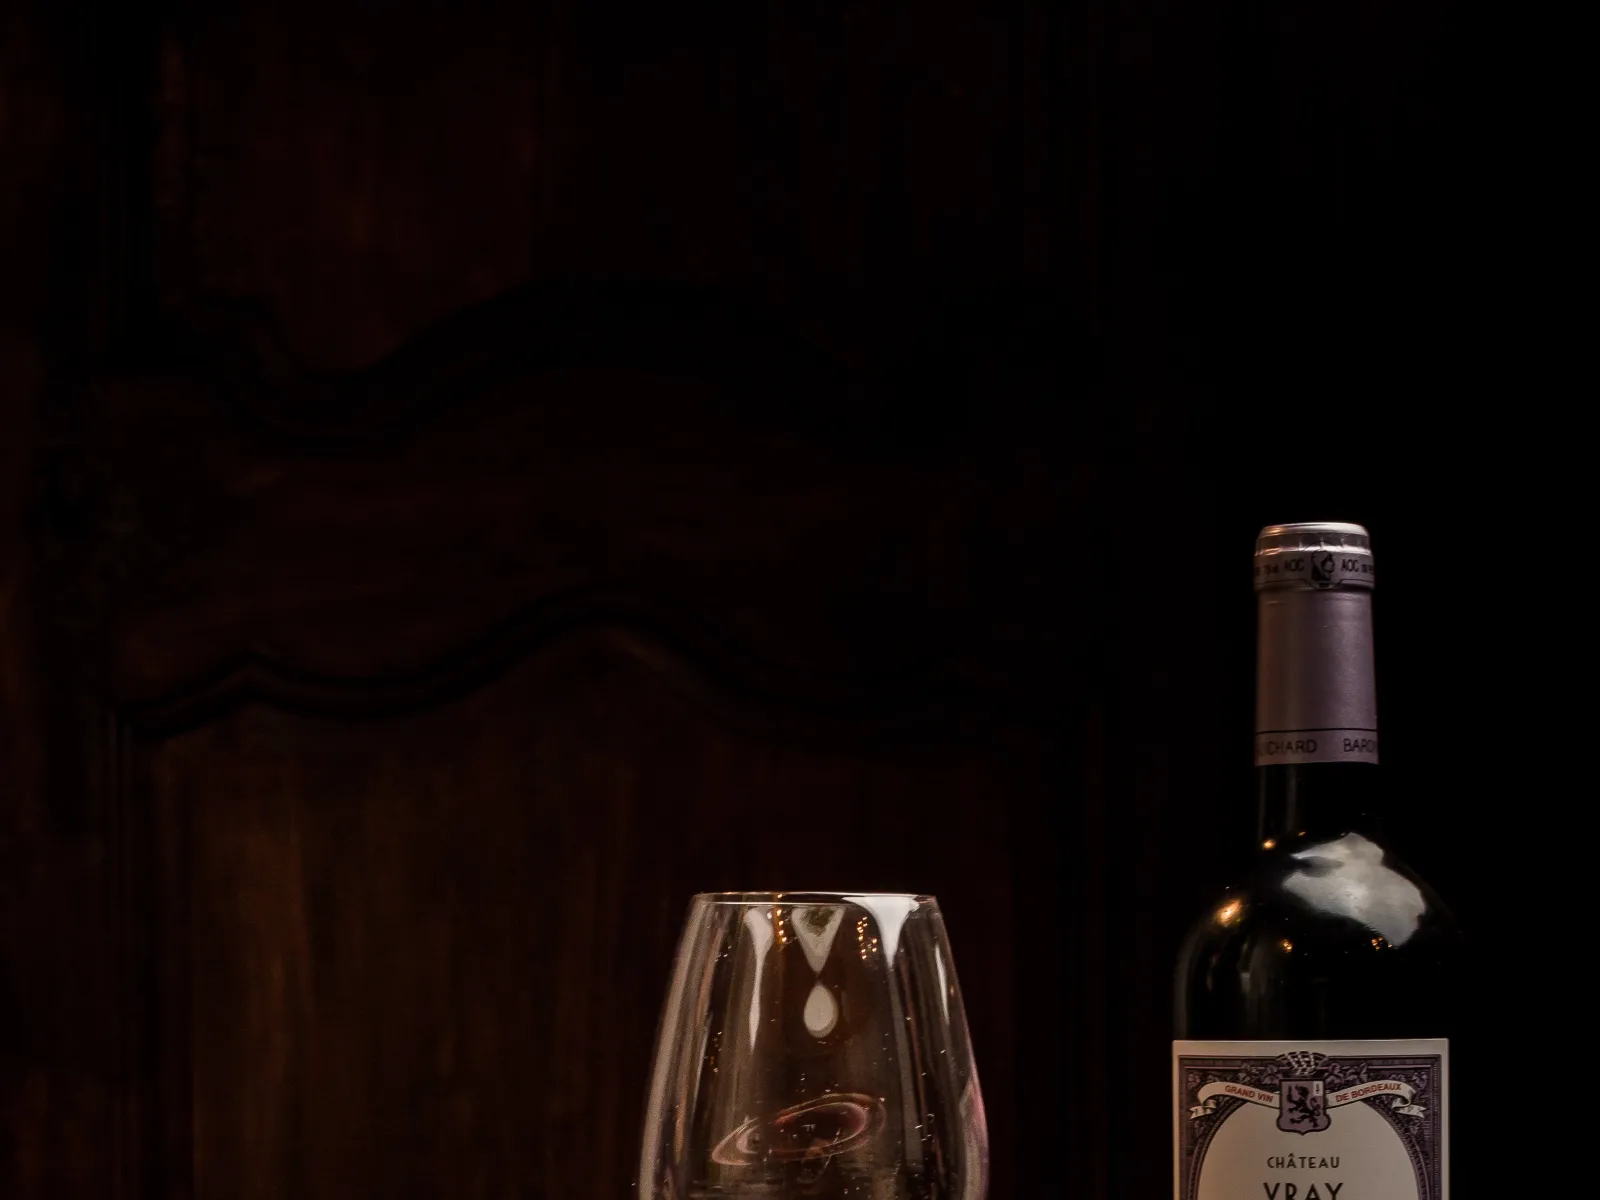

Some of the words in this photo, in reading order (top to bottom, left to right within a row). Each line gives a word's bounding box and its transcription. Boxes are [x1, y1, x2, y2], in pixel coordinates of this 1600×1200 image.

[1260, 739, 1318, 755] CHARD
[1224, 1085, 1255, 1100] GRAND
[1257, 1092, 1274, 1103] VIN
[1335, 1093, 1350, 1103] DE
[1351, 1082, 1402, 1099] BORDEAUX
[1266, 1152, 1340, 1169] CHÂTEAU
